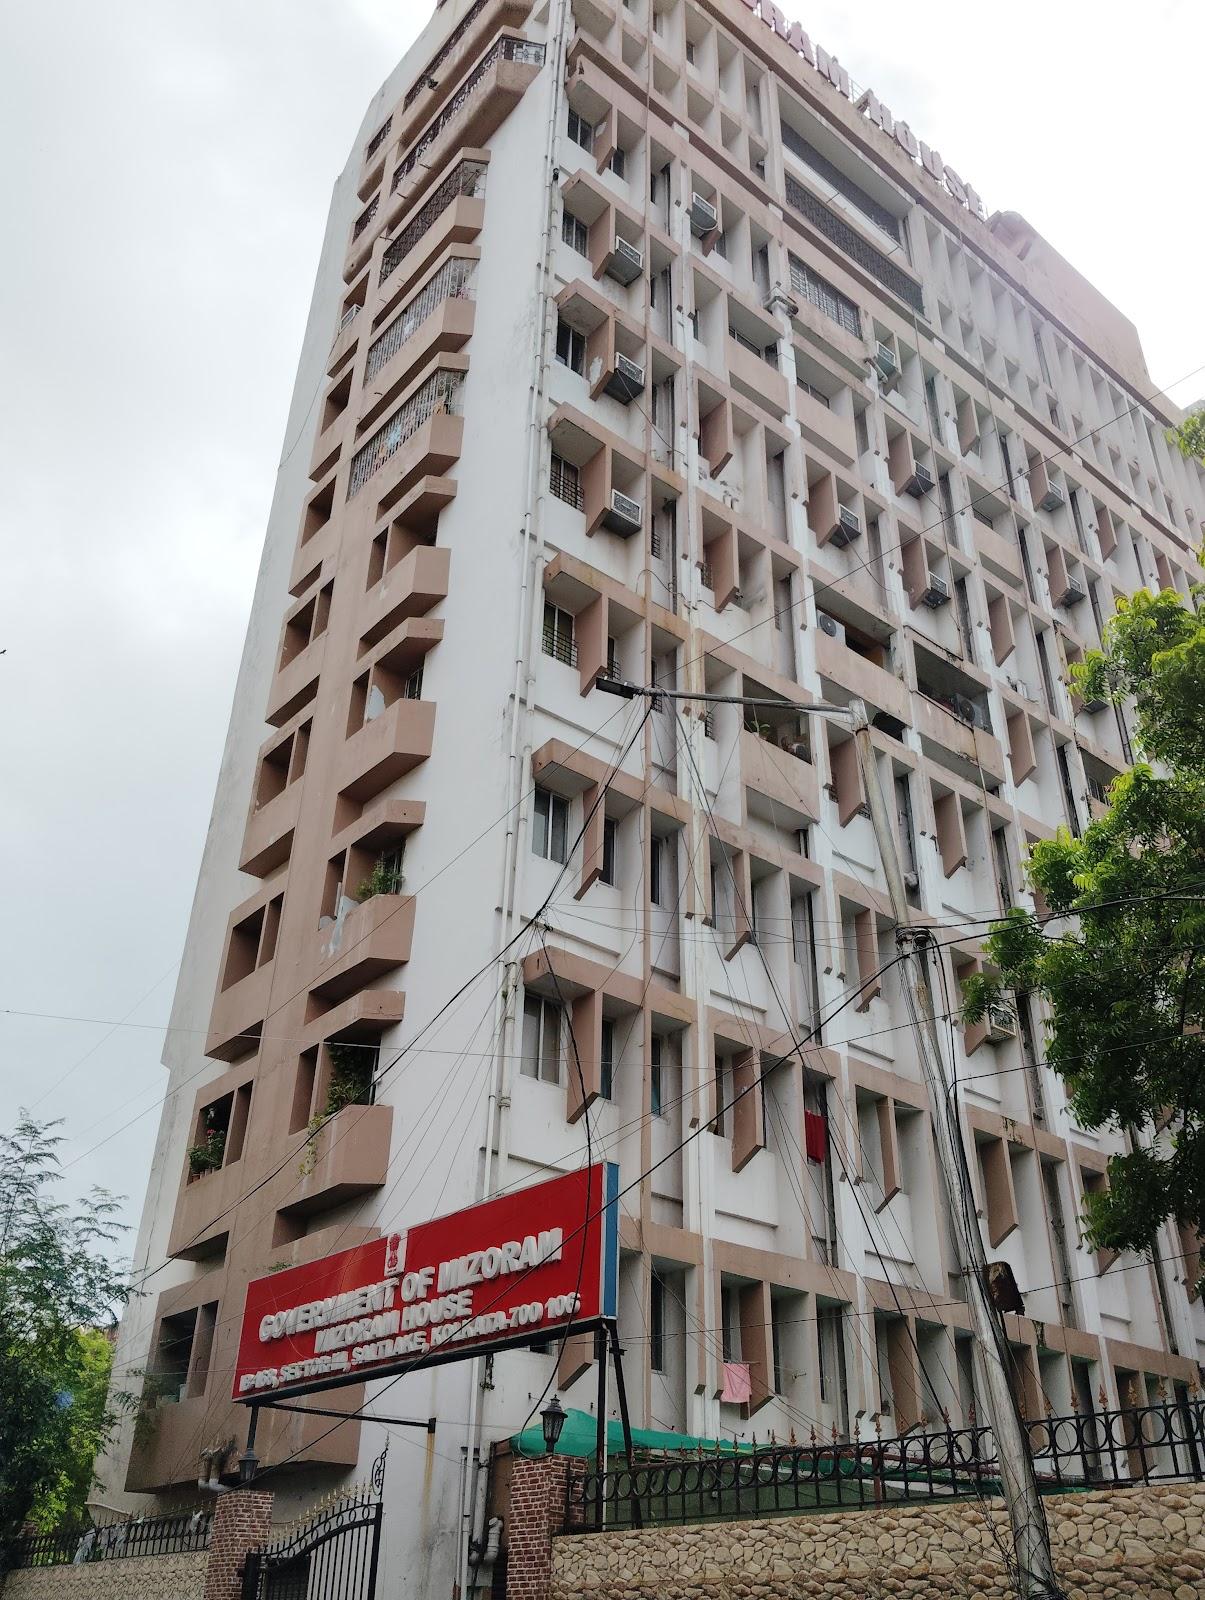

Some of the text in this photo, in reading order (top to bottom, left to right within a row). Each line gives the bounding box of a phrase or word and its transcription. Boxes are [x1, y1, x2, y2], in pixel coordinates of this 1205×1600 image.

[740, 0, 985, 222] RAM HOUSE
[259, 1227, 564, 1342] GOVERNMENT OF MIZORAM
[314, 1289, 474, 1354] MIZORAM HOUSE
[430, 1301, 544, 1347] KOLKATA-700
[544, 1292, 582, 1320] 106
